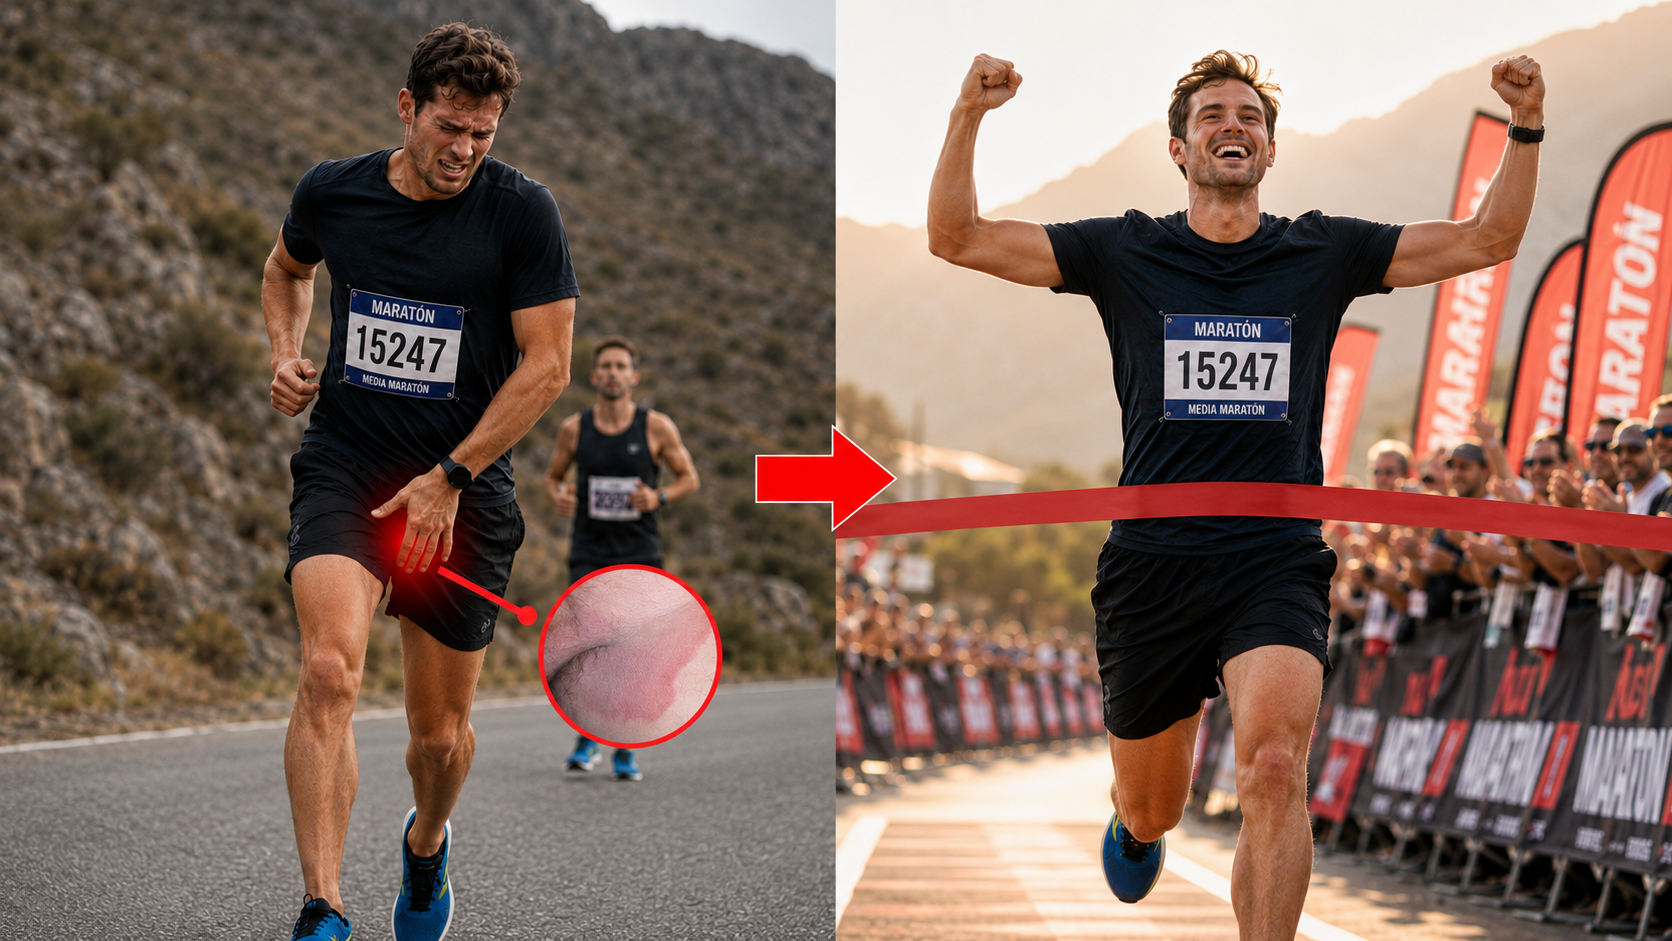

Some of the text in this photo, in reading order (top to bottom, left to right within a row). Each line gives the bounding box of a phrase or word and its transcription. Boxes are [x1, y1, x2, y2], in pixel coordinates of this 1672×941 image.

[371, 299, 435, 324] MARATÓN
[1194, 319, 1261, 338] MARATÓN
[356, 325, 447, 373] 15247
[1177, 350, 1278, 391] 15247
[362, 374, 430, 394] MEDIA MARATÓN
[1188, 402, 1265, 415] MEDIA MARATÓN
